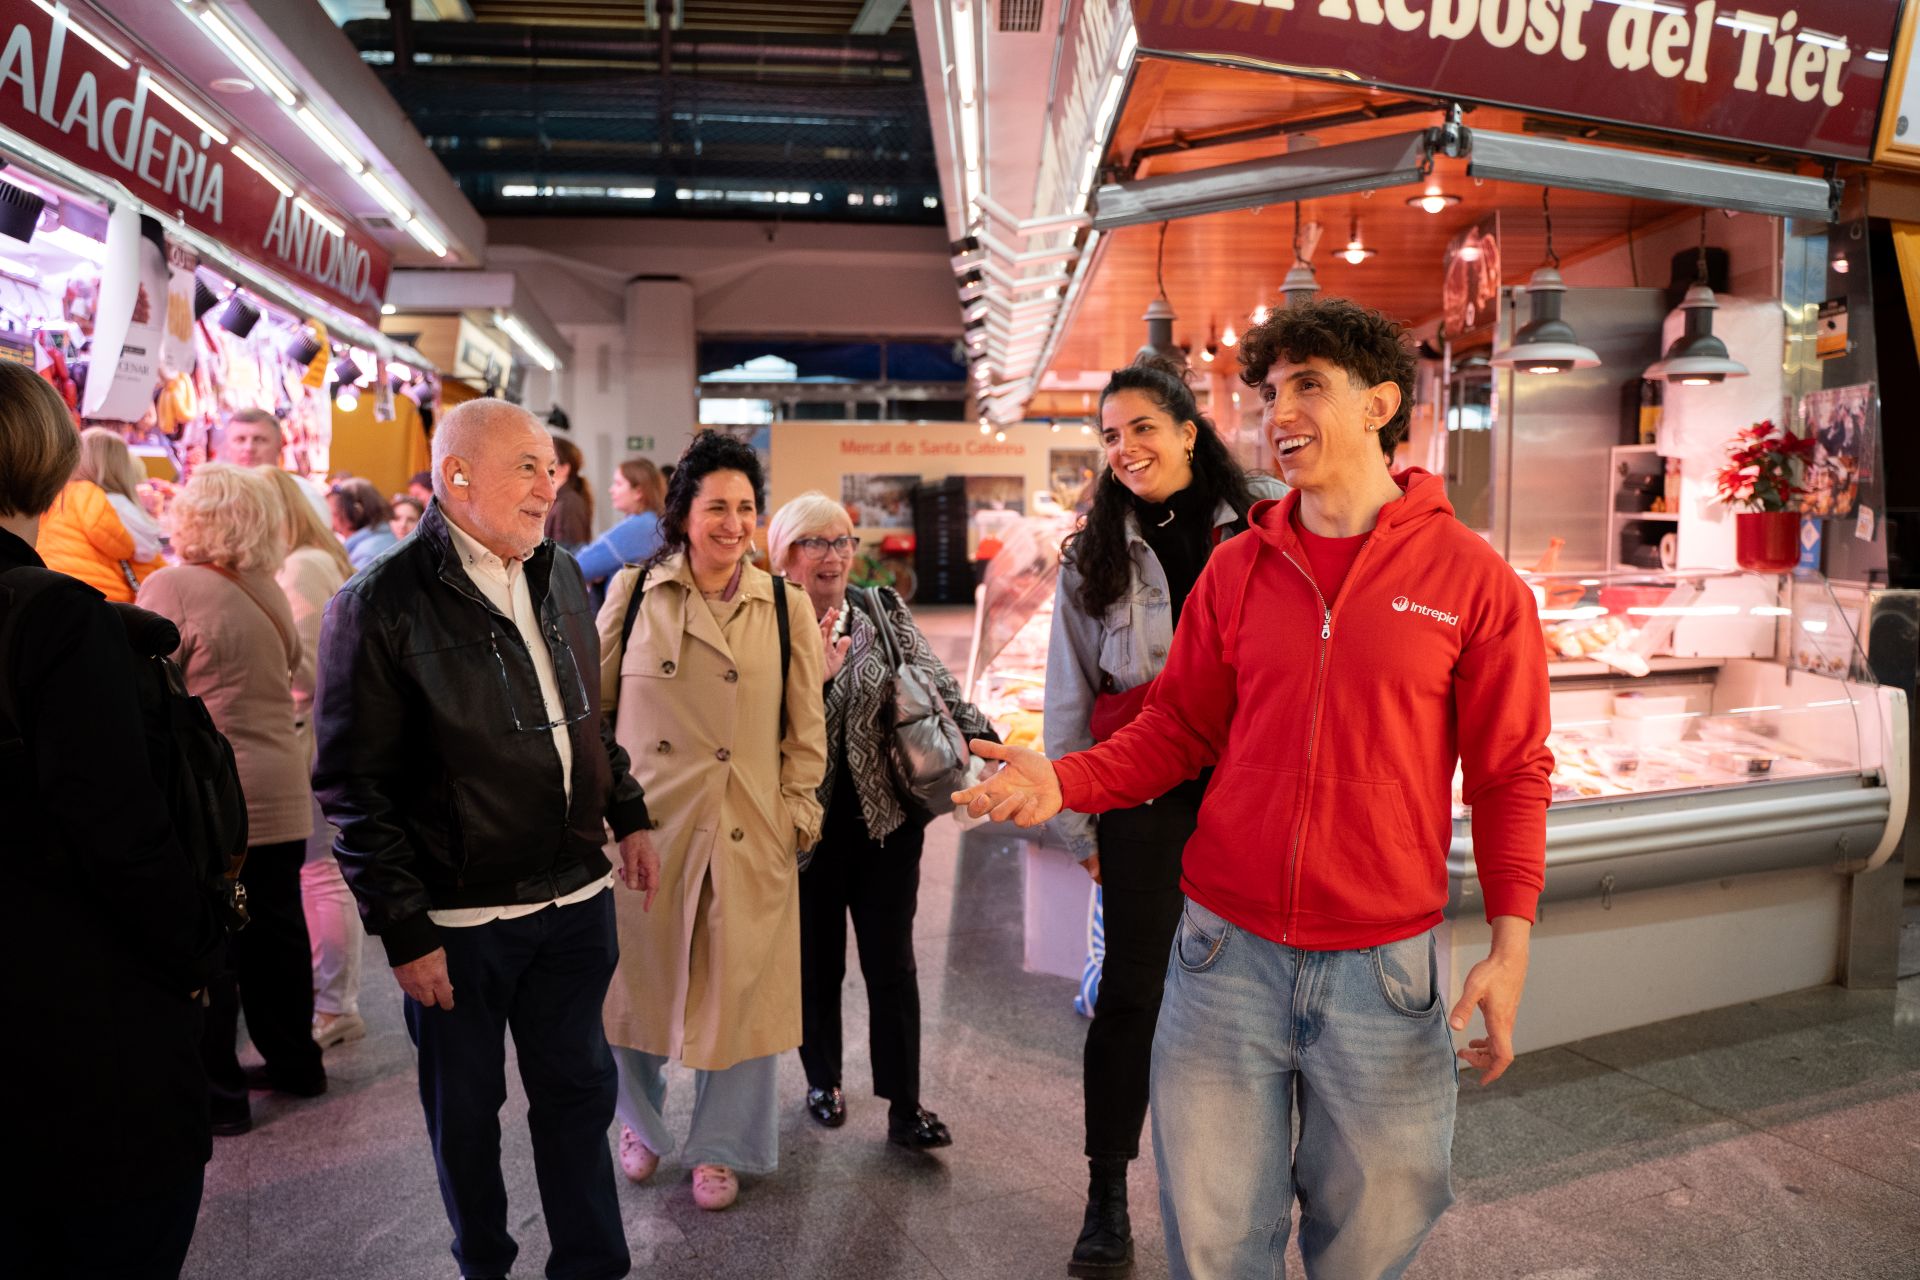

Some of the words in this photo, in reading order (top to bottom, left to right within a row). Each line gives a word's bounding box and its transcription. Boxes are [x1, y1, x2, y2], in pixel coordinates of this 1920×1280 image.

[1607, 0, 1716, 83] del
[1733, 9, 1851, 107] Tiet
[262, 192, 371, 304] ANTONIO
[840, 439, 891, 455] Mercat
[896, 440, 914, 456] de
[919, 439, 961, 456] Santa
[1410, 601, 1459, 626] Intrepid
